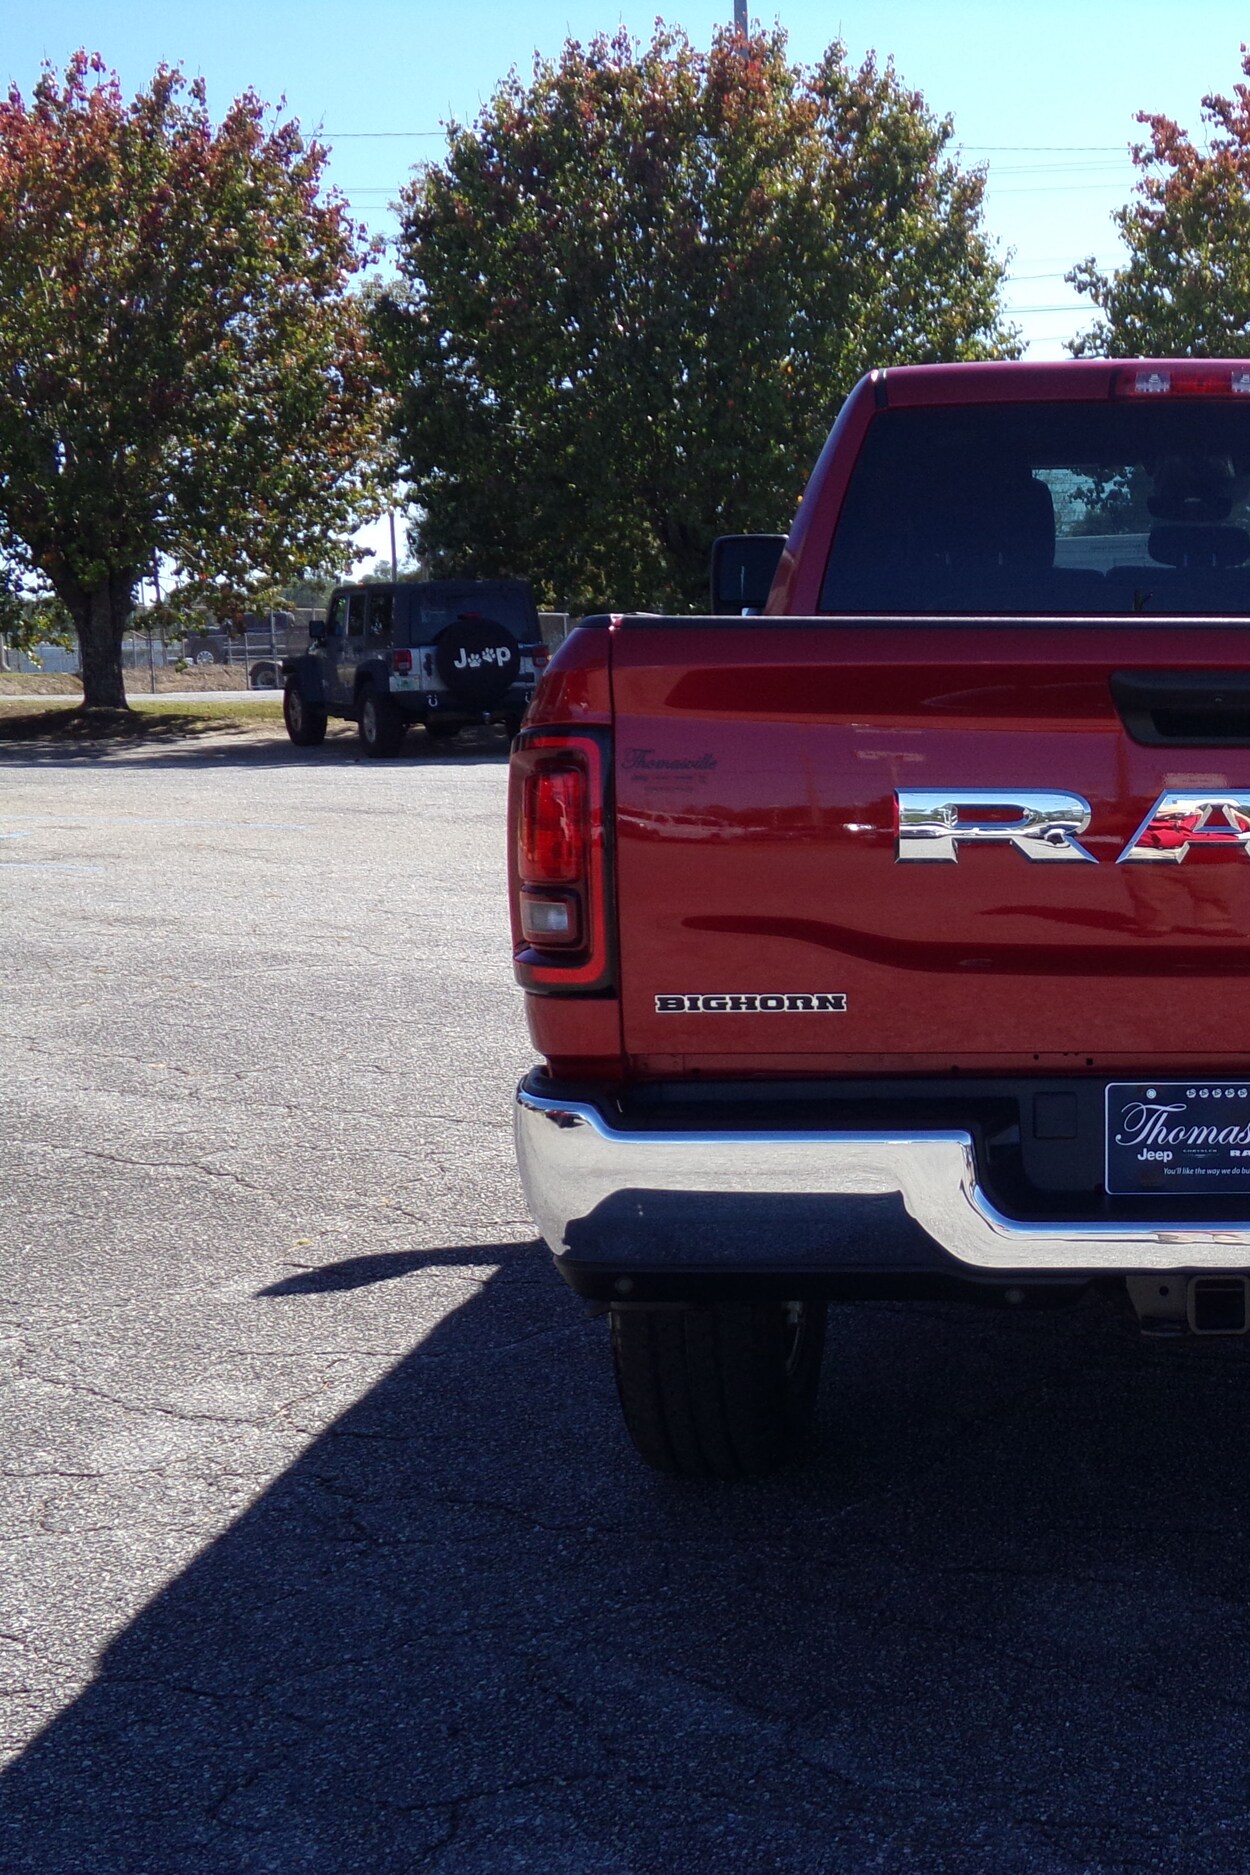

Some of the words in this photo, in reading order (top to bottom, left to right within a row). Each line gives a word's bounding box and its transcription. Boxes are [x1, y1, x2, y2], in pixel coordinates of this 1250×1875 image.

[655, 993, 847, 1013] BIGHORN
[1137, 1148, 1173, 1162] Jeep
[1163, 1167, 1182, 1175] You'll
[1182, 1167, 1194, 1175] like
[1195, 1167, 1206, 1175] the
[1206, 1168, 1220, 1176] way
